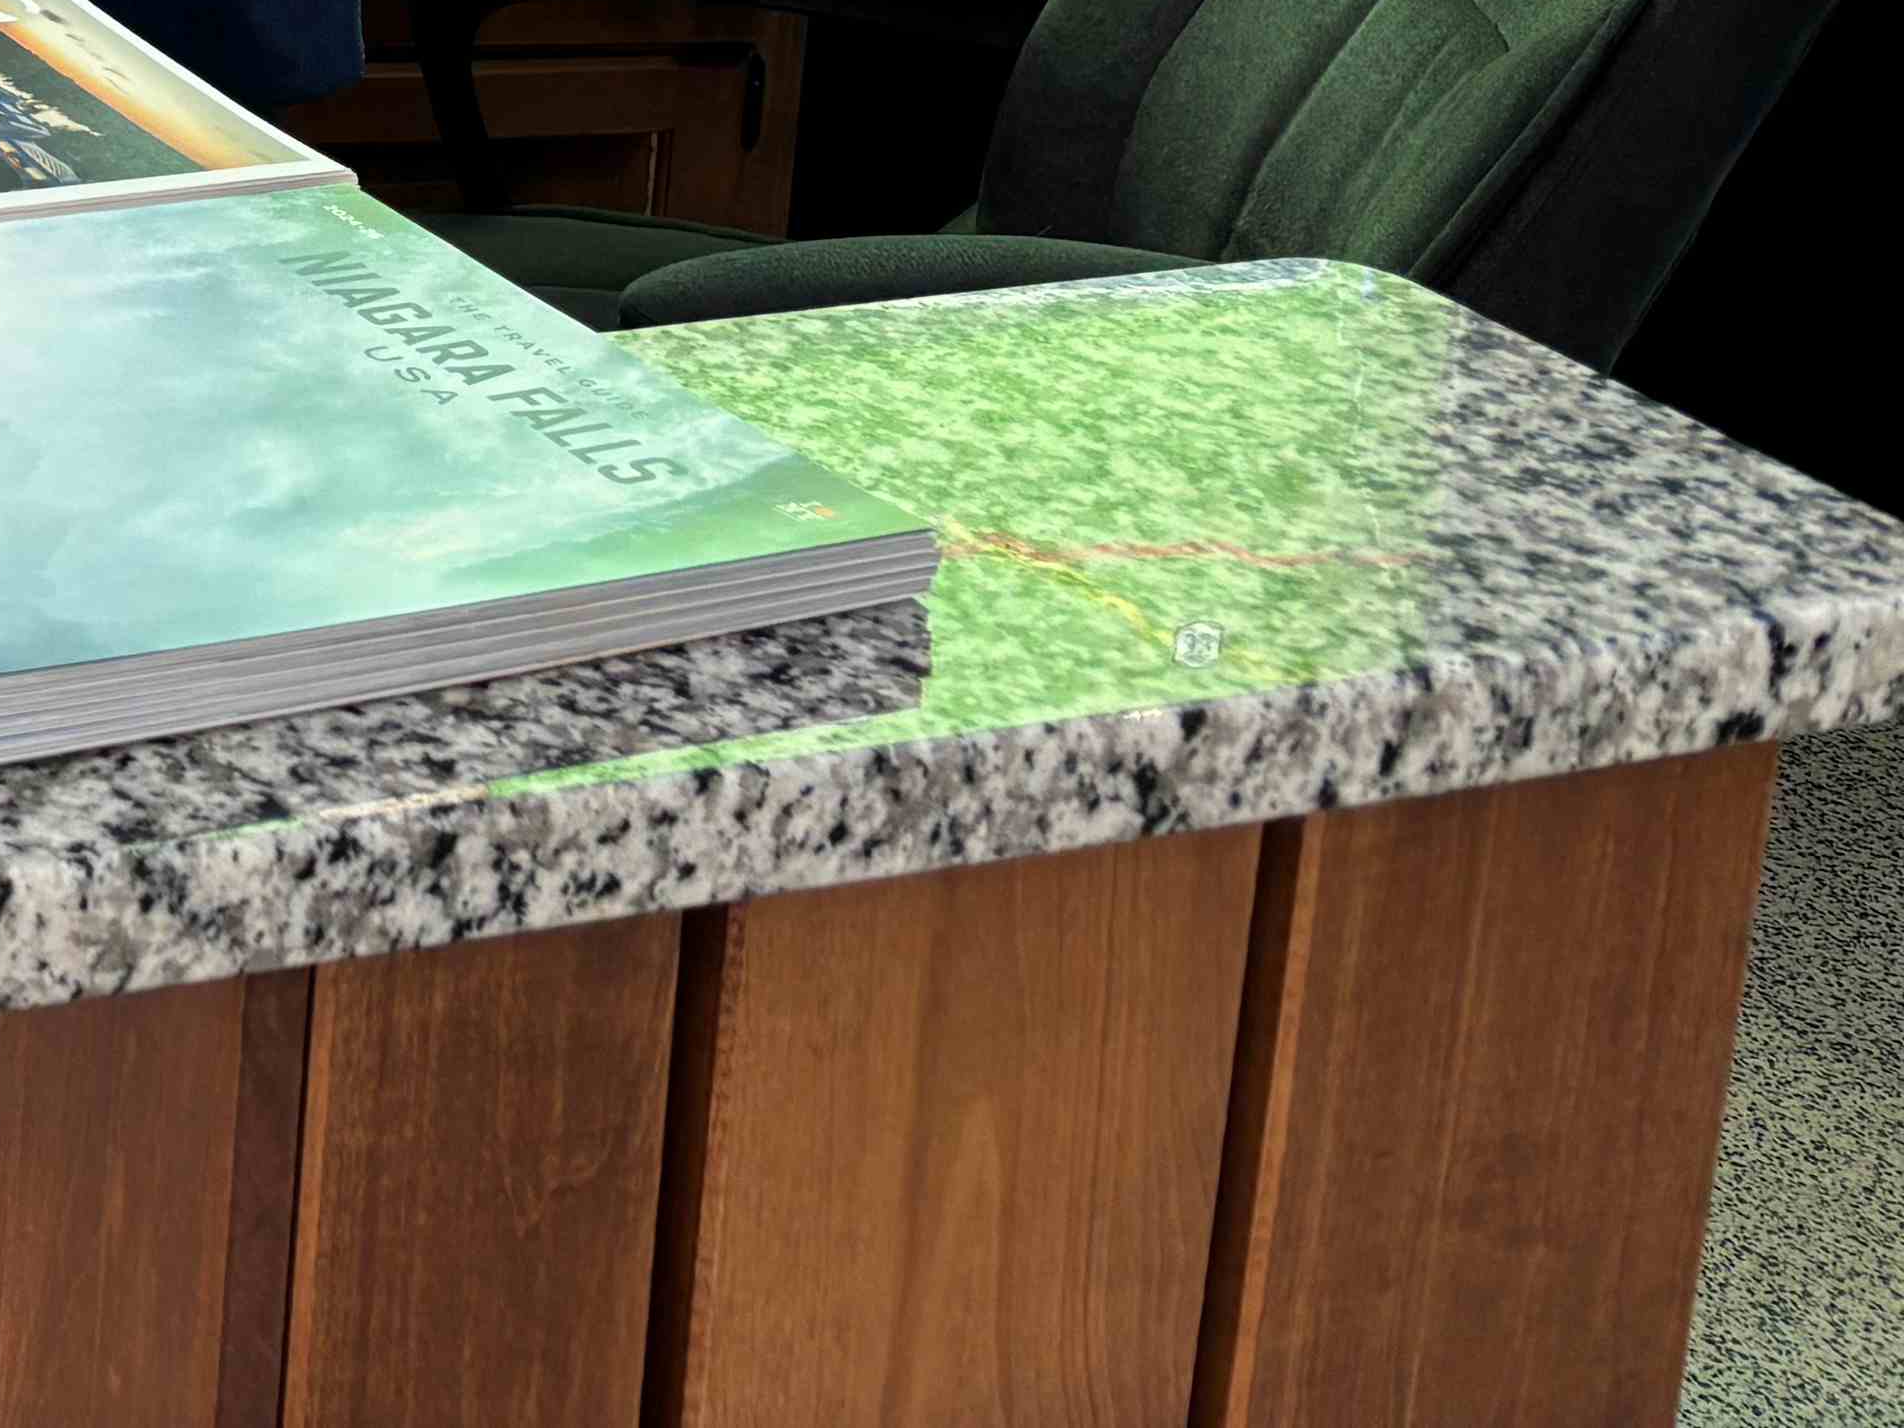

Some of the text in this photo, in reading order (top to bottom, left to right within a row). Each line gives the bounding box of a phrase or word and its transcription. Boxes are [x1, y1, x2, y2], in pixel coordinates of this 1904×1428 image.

[280, 249, 689, 485] NIAGARA FALLS
[364, 345, 459, 405] USA
